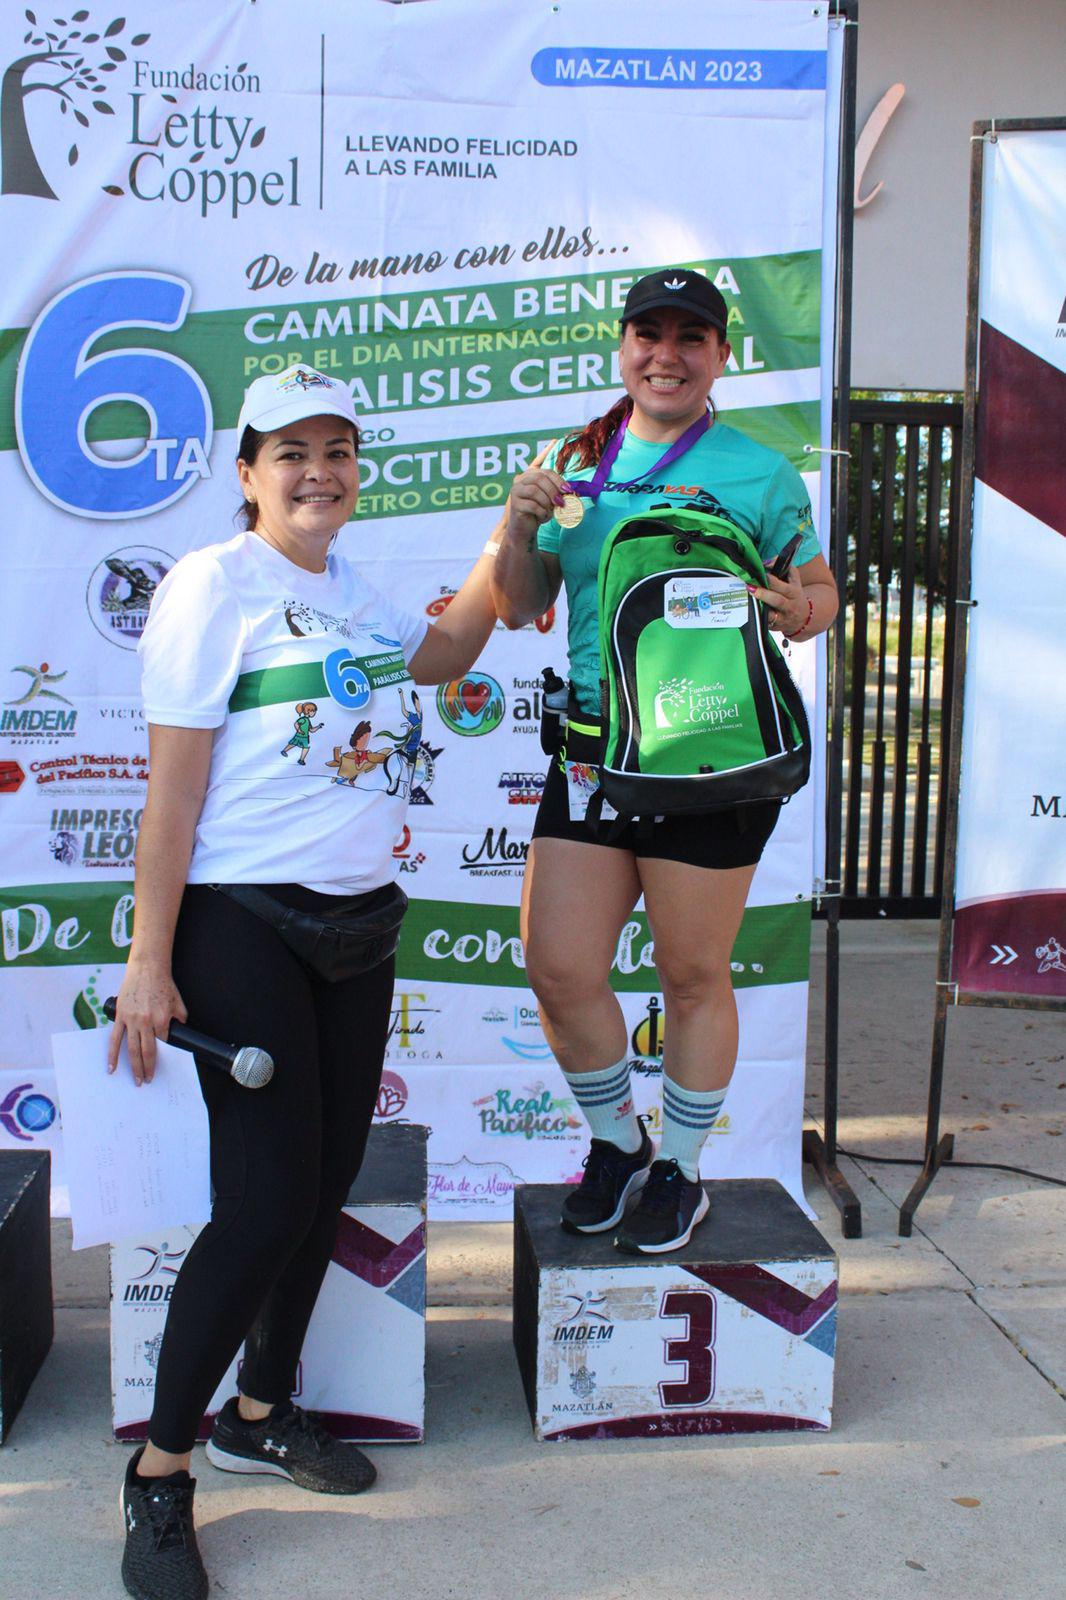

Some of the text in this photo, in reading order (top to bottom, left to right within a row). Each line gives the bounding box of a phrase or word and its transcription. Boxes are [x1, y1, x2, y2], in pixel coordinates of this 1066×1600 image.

[133, 60, 261, 93] Fundación
[555, 56, 763, 83] MAZATLÁN 2023
[127, 92, 253, 166] Letty
[345, 135, 578, 157] LLEVANDO FELICIDAD
[344, 160, 498, 180] A LAS FAMILIA
[128, 151, 302, 219] Coppel
[245, 225, 630, 292] De la mano con ellos...
[243, 265, 742, 345] CAMINATA BENEA
[243, 352, 303, 377] POR
[314, 348, 343, 370] EL
[352, 342, 403, 366] DIA
[412, 319, 622, 360] INTERNACION
[15, 269, 214, 521] 6
[146, 437, 212, 482] TA
[430, 483, 504, 506] CERO
[322, 648, 371, 711] 6
[688, 694, 723, 710] Letty
[689, 703, 740, 725] Coppel
[0, 710, 77, 731] IMDEM
[30, 755, 147, 773] Control Técnico de
[36, 772, 56, 784] del
[57, 768, 106, 781] Pacífico
[498, 773, 547, 789] AUTO
[83, 829, 135, 860] LEÓ
[2, 903, 91, 961] De
[423, 929, 527, 969] con
[495, 1089, 553, 1114] Real
[458, 1176, 470, 1192] de
[123, 1284, 175, 1302] IMDE
[553, 1324, 614, 1341] IMDEM
[658, 1289, 717, 1409] 3
